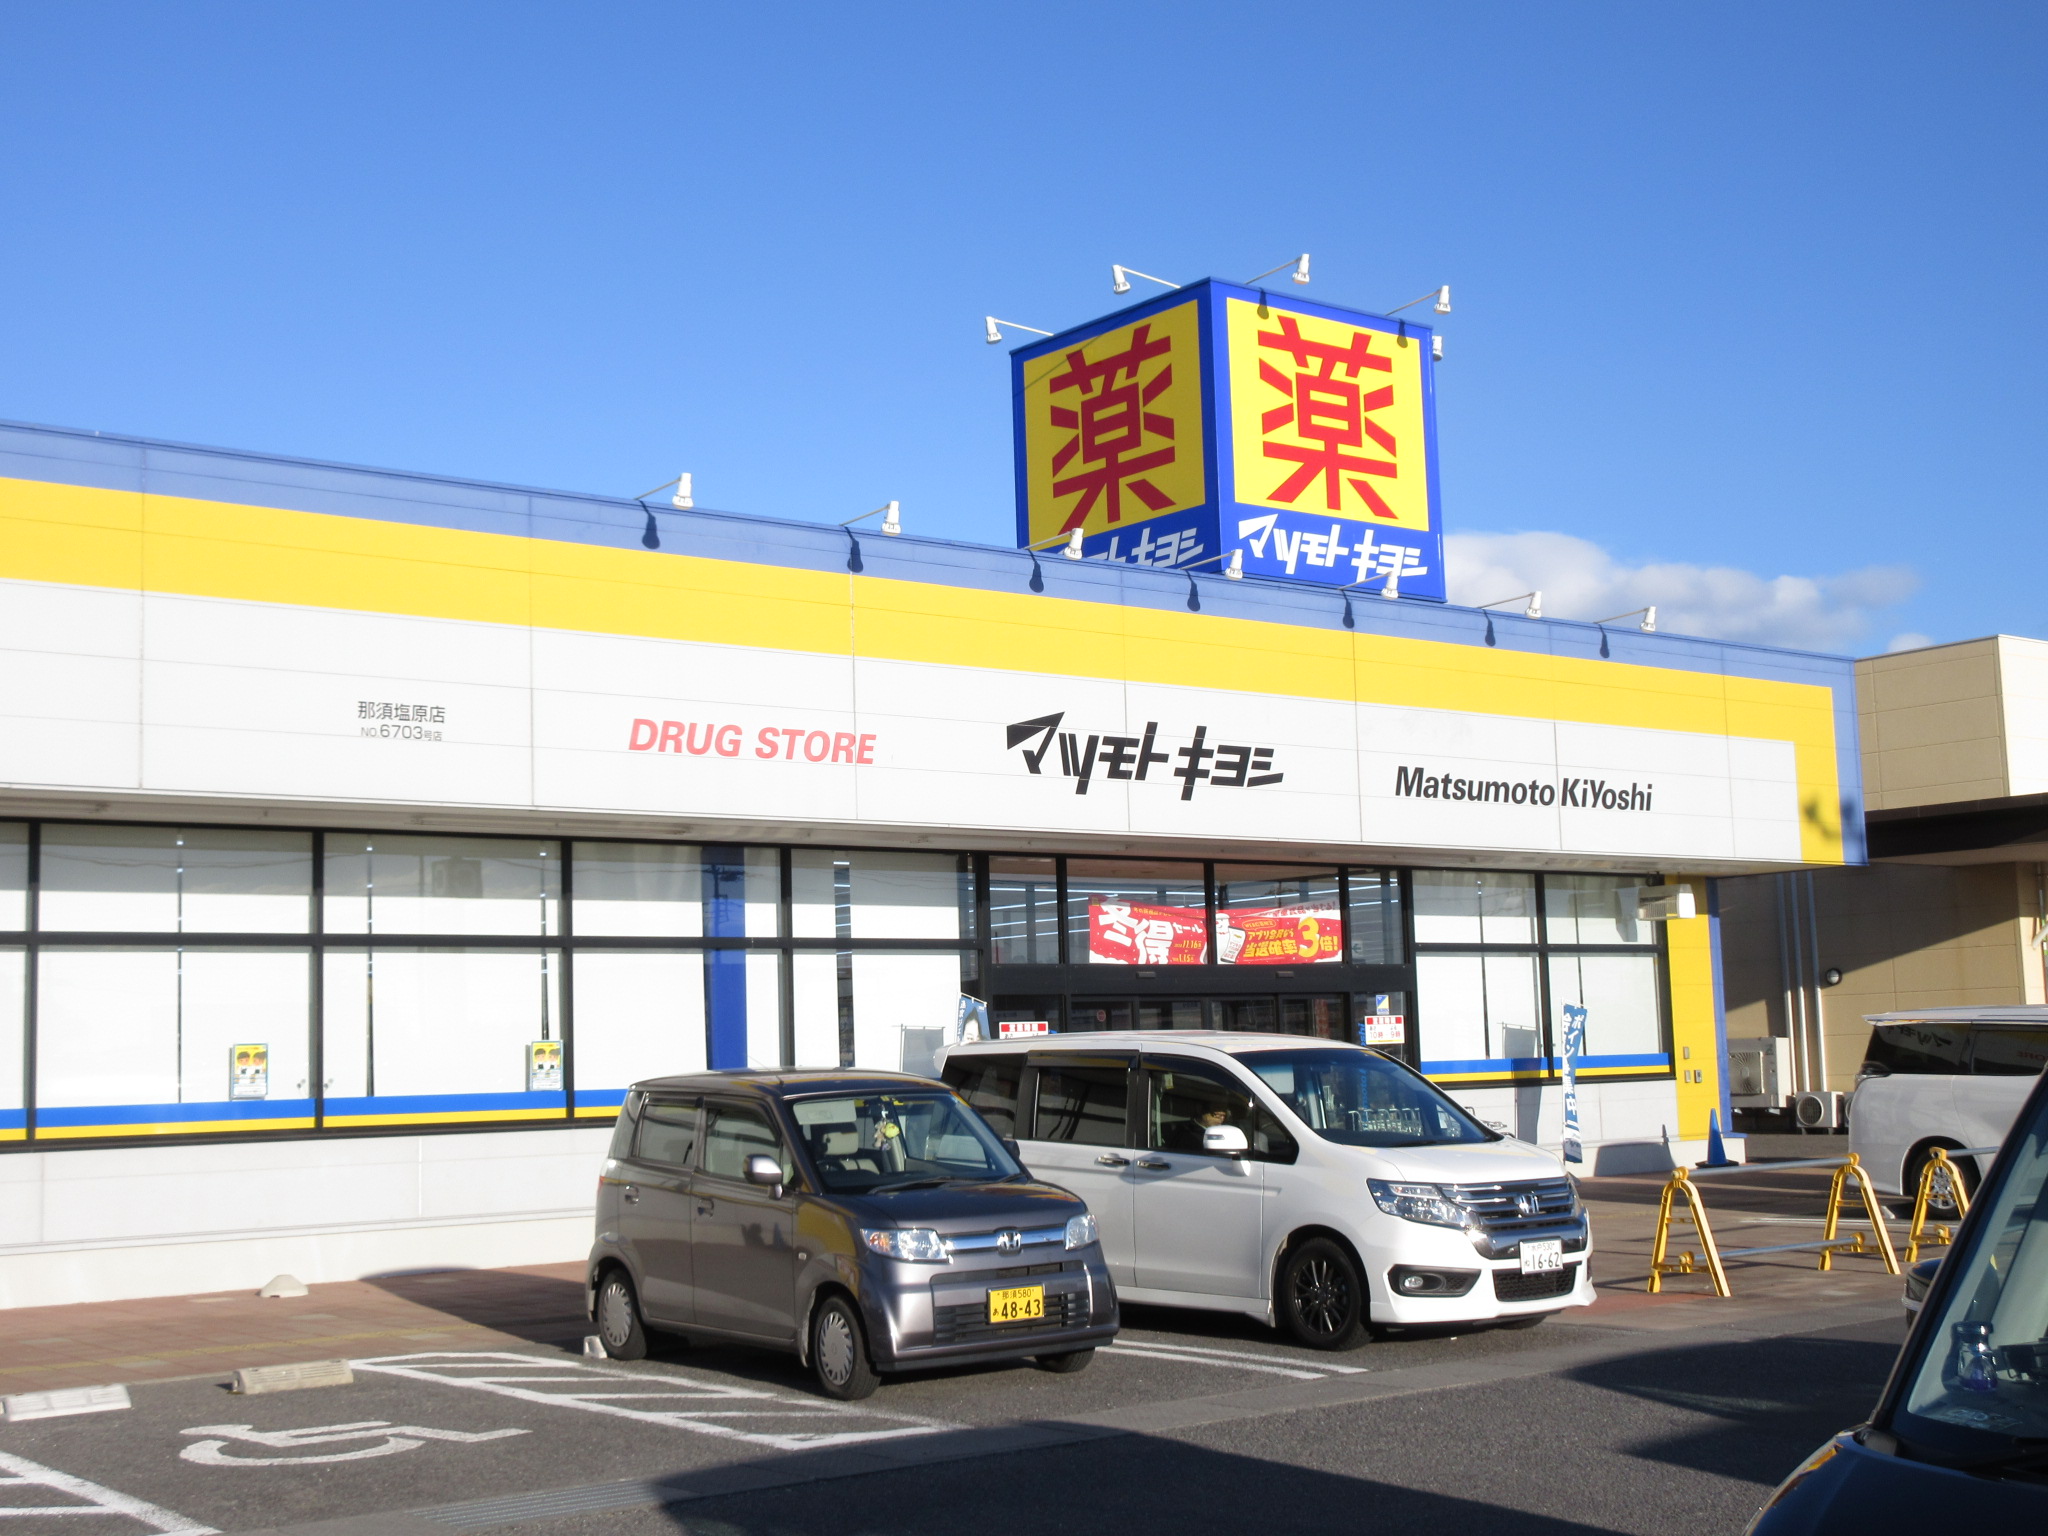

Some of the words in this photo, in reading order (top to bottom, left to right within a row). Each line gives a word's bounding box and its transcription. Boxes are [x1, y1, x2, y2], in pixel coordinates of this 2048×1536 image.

[1049, 323, 1177, 534] 薬
[1257, 315, 1399, 520] 薬
[1058, 527, 1204, 568] トキヨシ
[1238, 513, 1429, 584] マツモトキヨシ
[357, 700, 446, 724] 那須塩原店
[628, 718, 742, 757] DRUG
[755, 726, 877, 765] STORE
[1006, 710, 1284, 801] マツモトキヨシ
[1394, 765, 1556, 807] Matsumoto
[1560, 777, 1653, 812] KiYoshi
[1001, 1288, 1032, 1300] 那須580
[1001, 1299, 1041, 1319] 48-43
